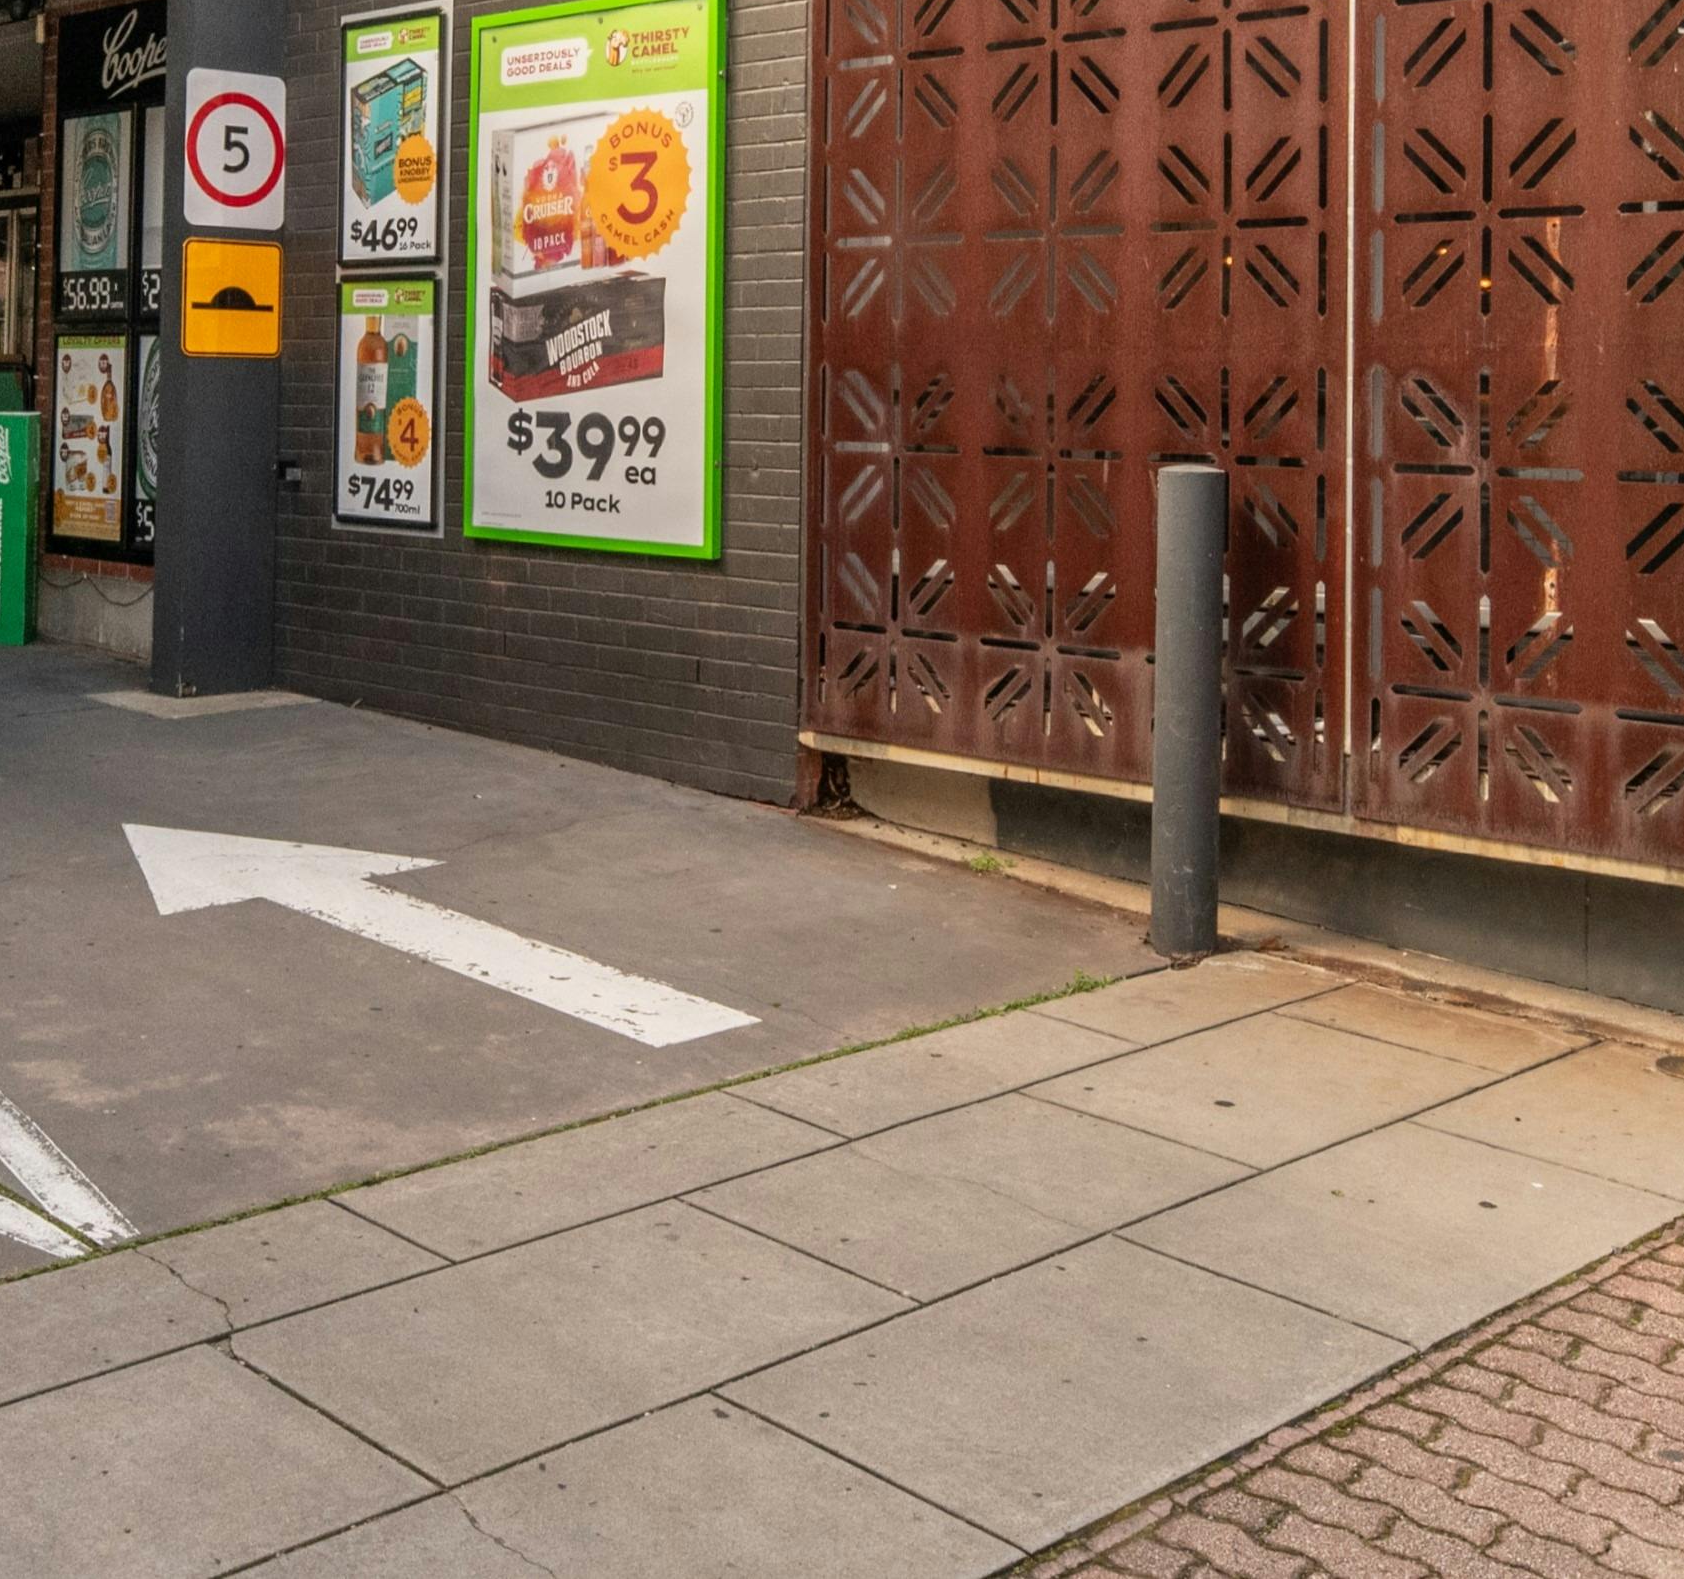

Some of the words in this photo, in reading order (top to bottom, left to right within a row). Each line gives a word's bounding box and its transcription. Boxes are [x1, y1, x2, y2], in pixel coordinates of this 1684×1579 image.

[631, 25, 690, 44] THIRSTY
[507, 48, 580, 66] UNSERIOUSLY
[631, 42, 678, 58] CAMEL
[507, 65, 537, 77] GOOD
[539, 60, 572, 73] DEALS
[610, 121, 672, 149] BONUS
[222, 126, 250, 173] 5
[399, 157, 432, 168] BONUS
[524, 195, 574, 224] CRUISER
[601, 213, 638, 246] CAMEL
[644, 209, 675, 243] CASH
[410, 240, 432, 250] Pack
[533, 237, 543, 250] 10
[544, 232, 566, 248] PACK
[546, 310, 612, 366] WOODSTOCK
[559, 341, 603, 376] BOURBON
[625, 466, 656, 485] ea
[545, 491, 565, 509] 10
[571, 493, 621, 513] Pack
